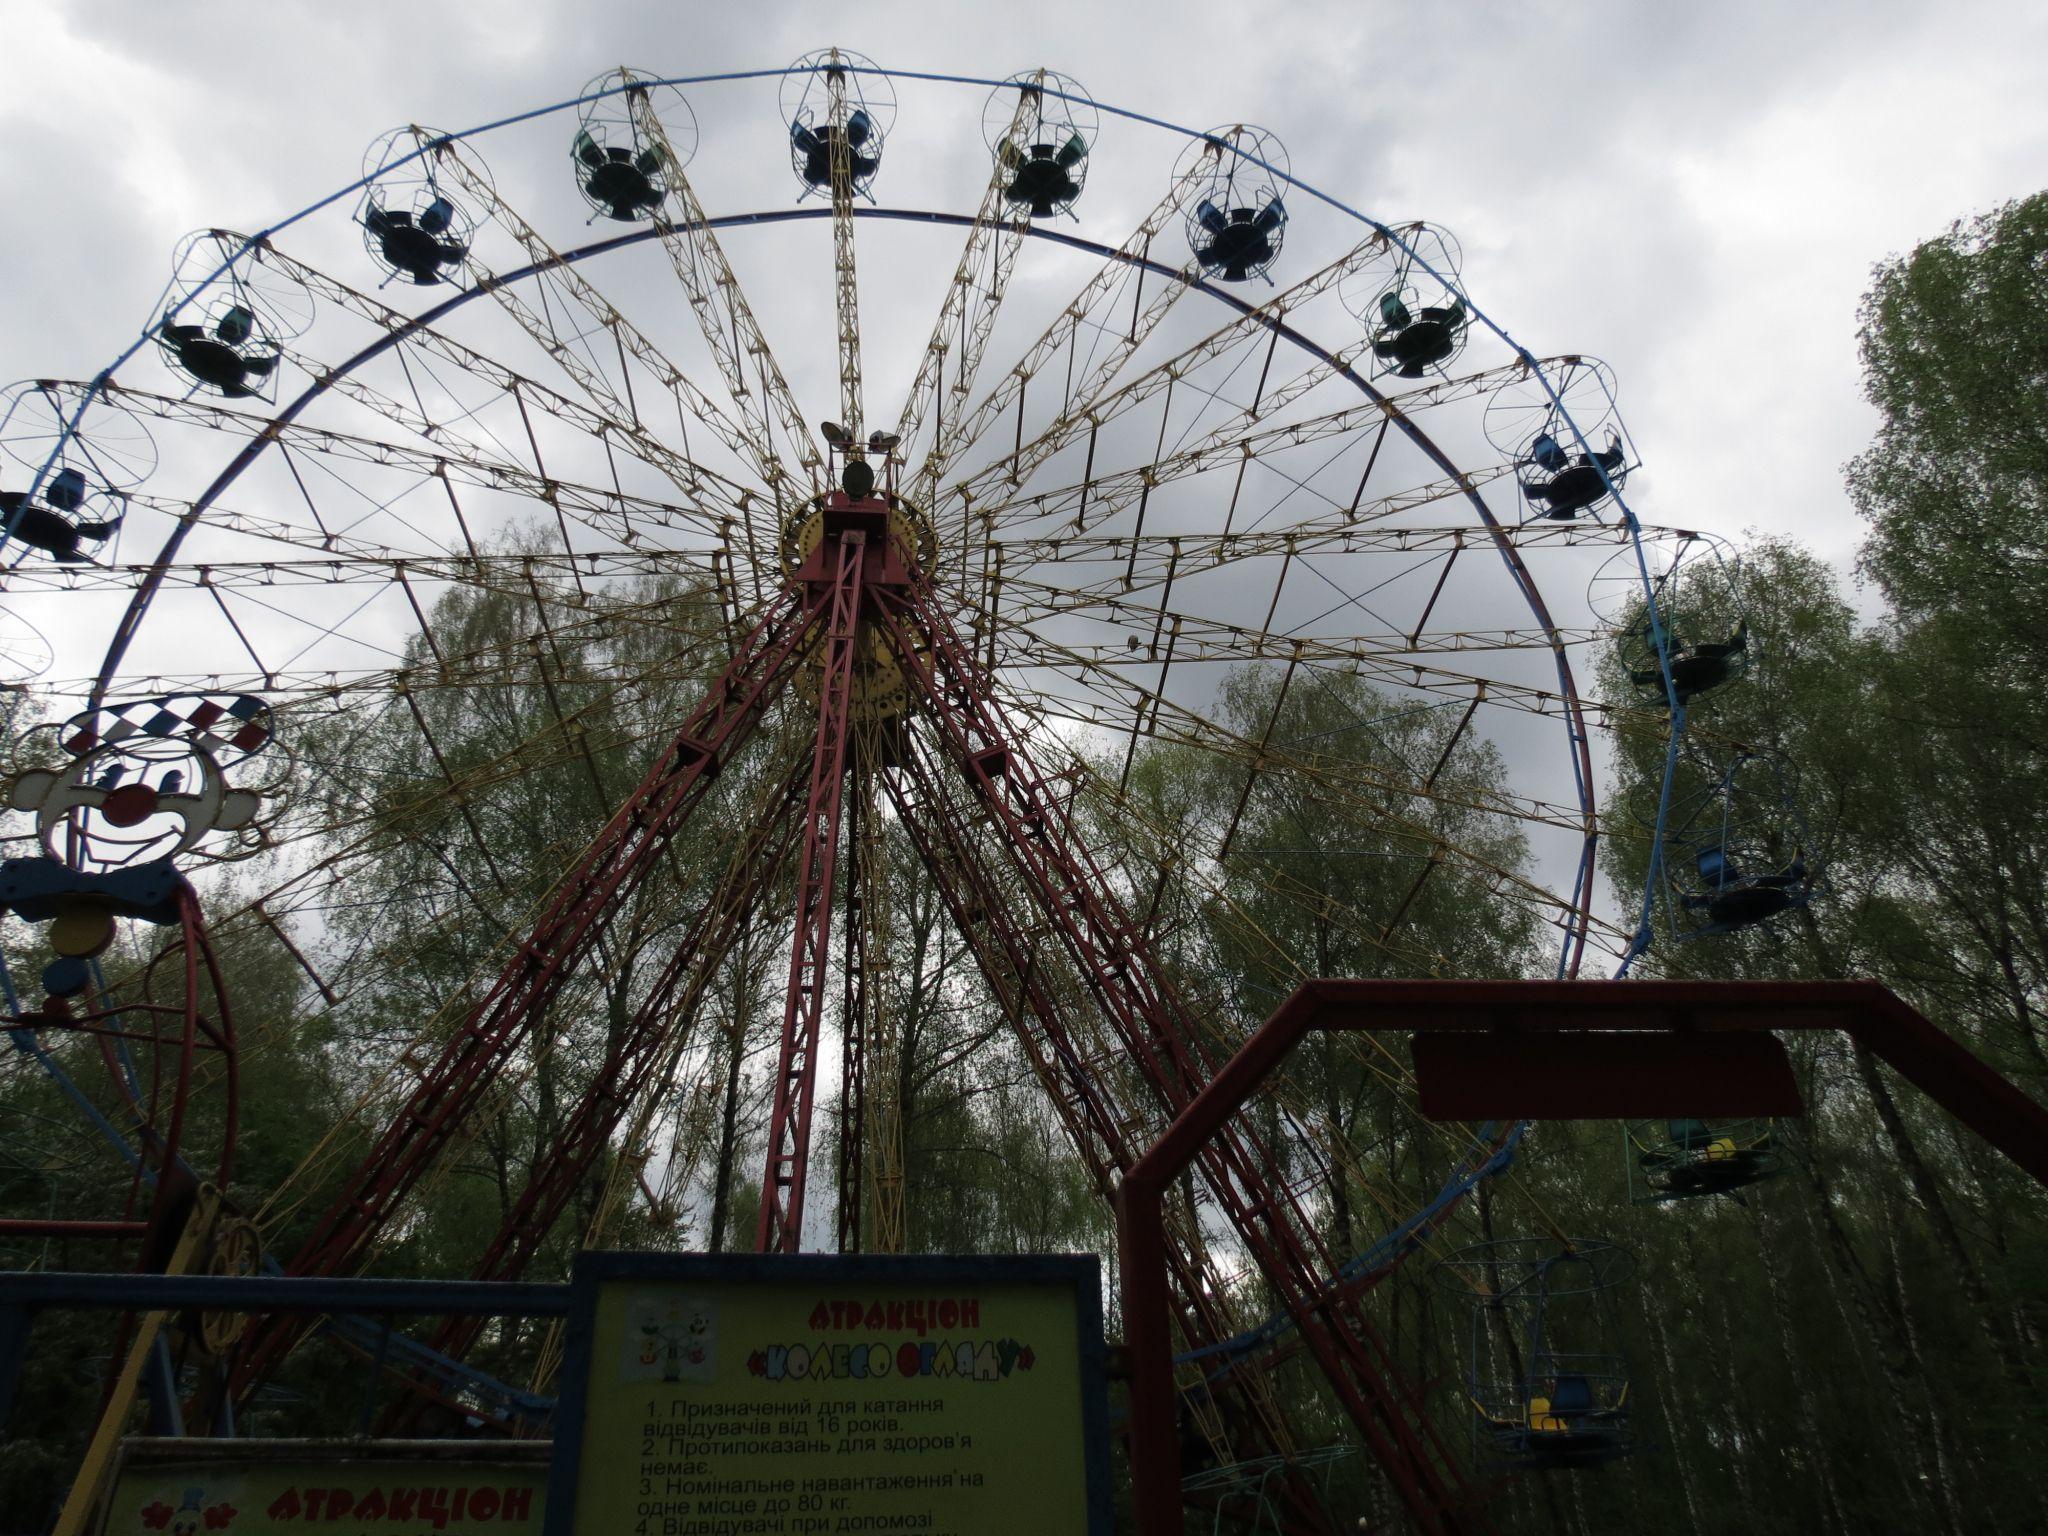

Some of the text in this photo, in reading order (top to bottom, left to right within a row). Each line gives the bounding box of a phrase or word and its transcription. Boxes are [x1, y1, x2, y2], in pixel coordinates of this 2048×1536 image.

[808, 1298, 980, 1336] АТРАКЦІОН
[647, 1399, 943, 1421] 1. Призначений для катання
[644, 1416, 903, 1440] відвідувачів від 16 років.
[641, 1432, 972, 1459] 2. Протипоказань для здоров'я
[640, 1461, 713, 1476] немає.
[639, 1473, 984, 1495] 3. Номінальне навантаження на
[267, 1486, 533, 1530] АТРАКЦІОН
[638, 1494, 850, 1518] одне місце до 80 кг.
[635, 1510, 932, 1536] 4. Відвідувачі при допомозі
